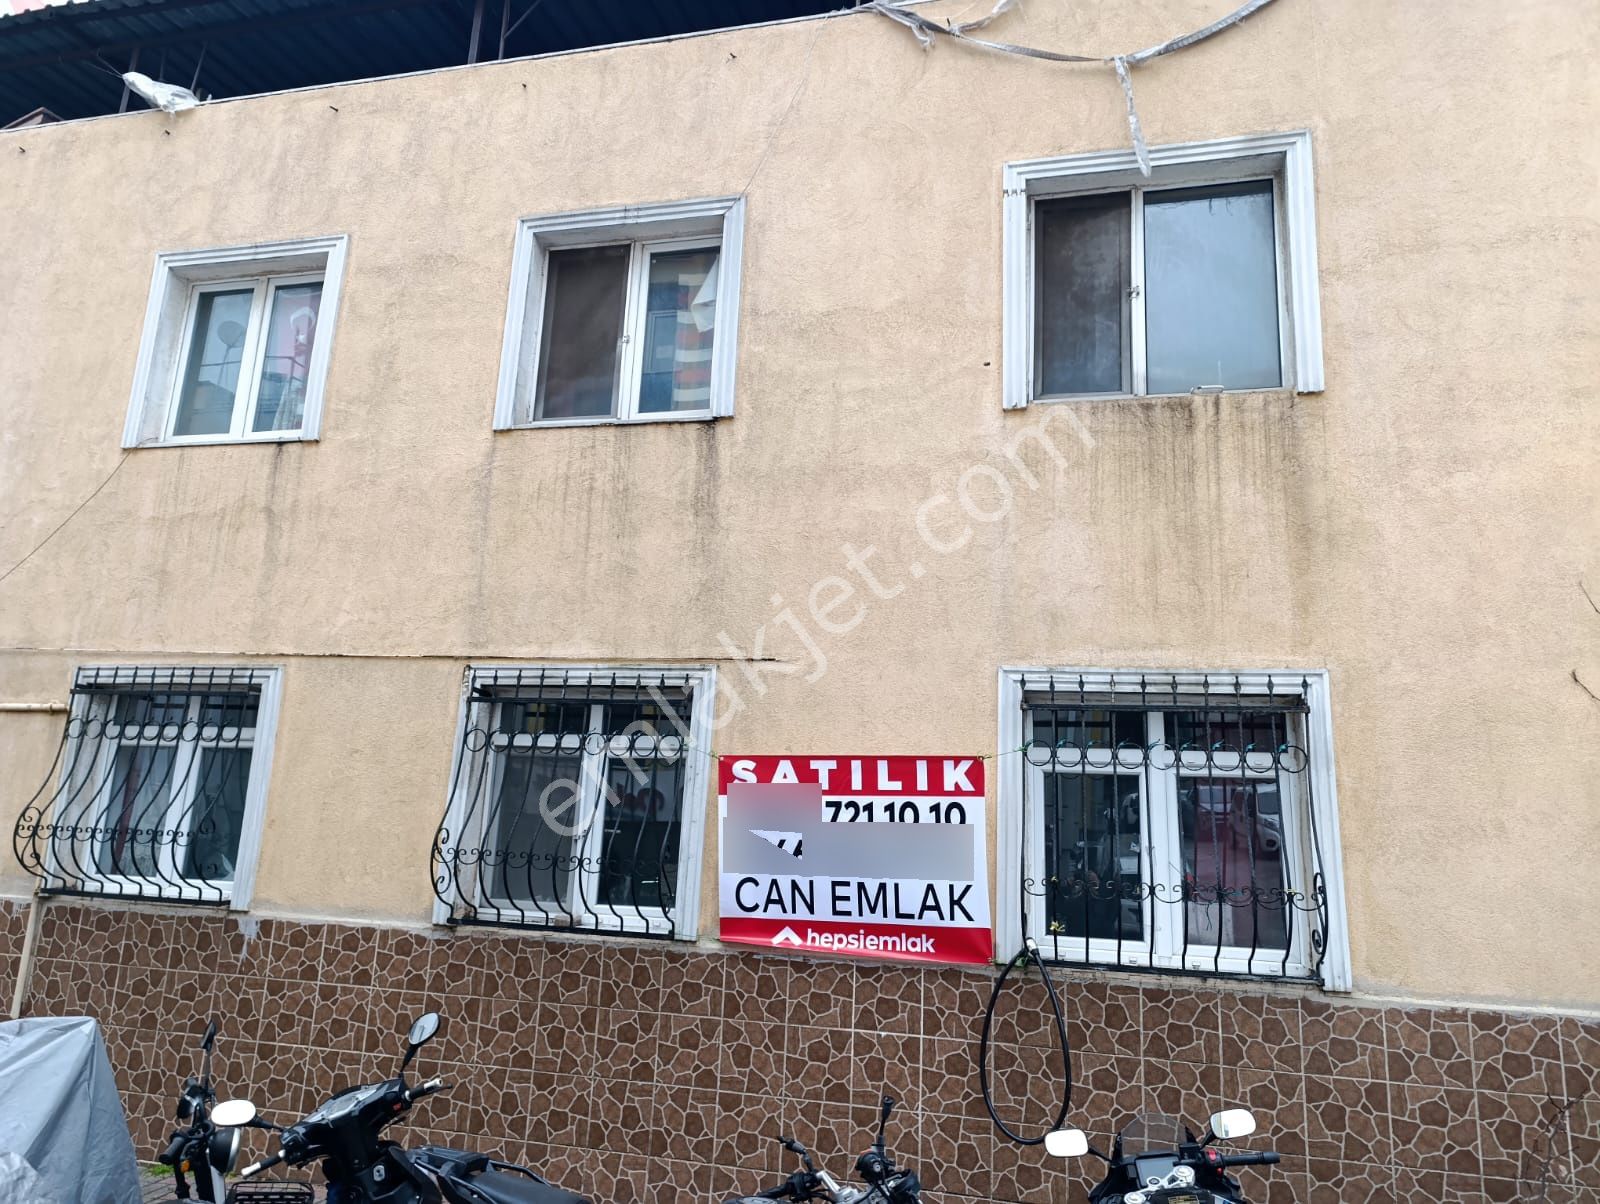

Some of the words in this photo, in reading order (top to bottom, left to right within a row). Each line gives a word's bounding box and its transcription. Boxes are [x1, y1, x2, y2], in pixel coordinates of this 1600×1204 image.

[731, 759, 976, 792] SATILIK
[735, 877, 815, 915] CAN
[831, 880, 975, 922] EMLAK
[806, 928, 936, 953] hepsiemlak
